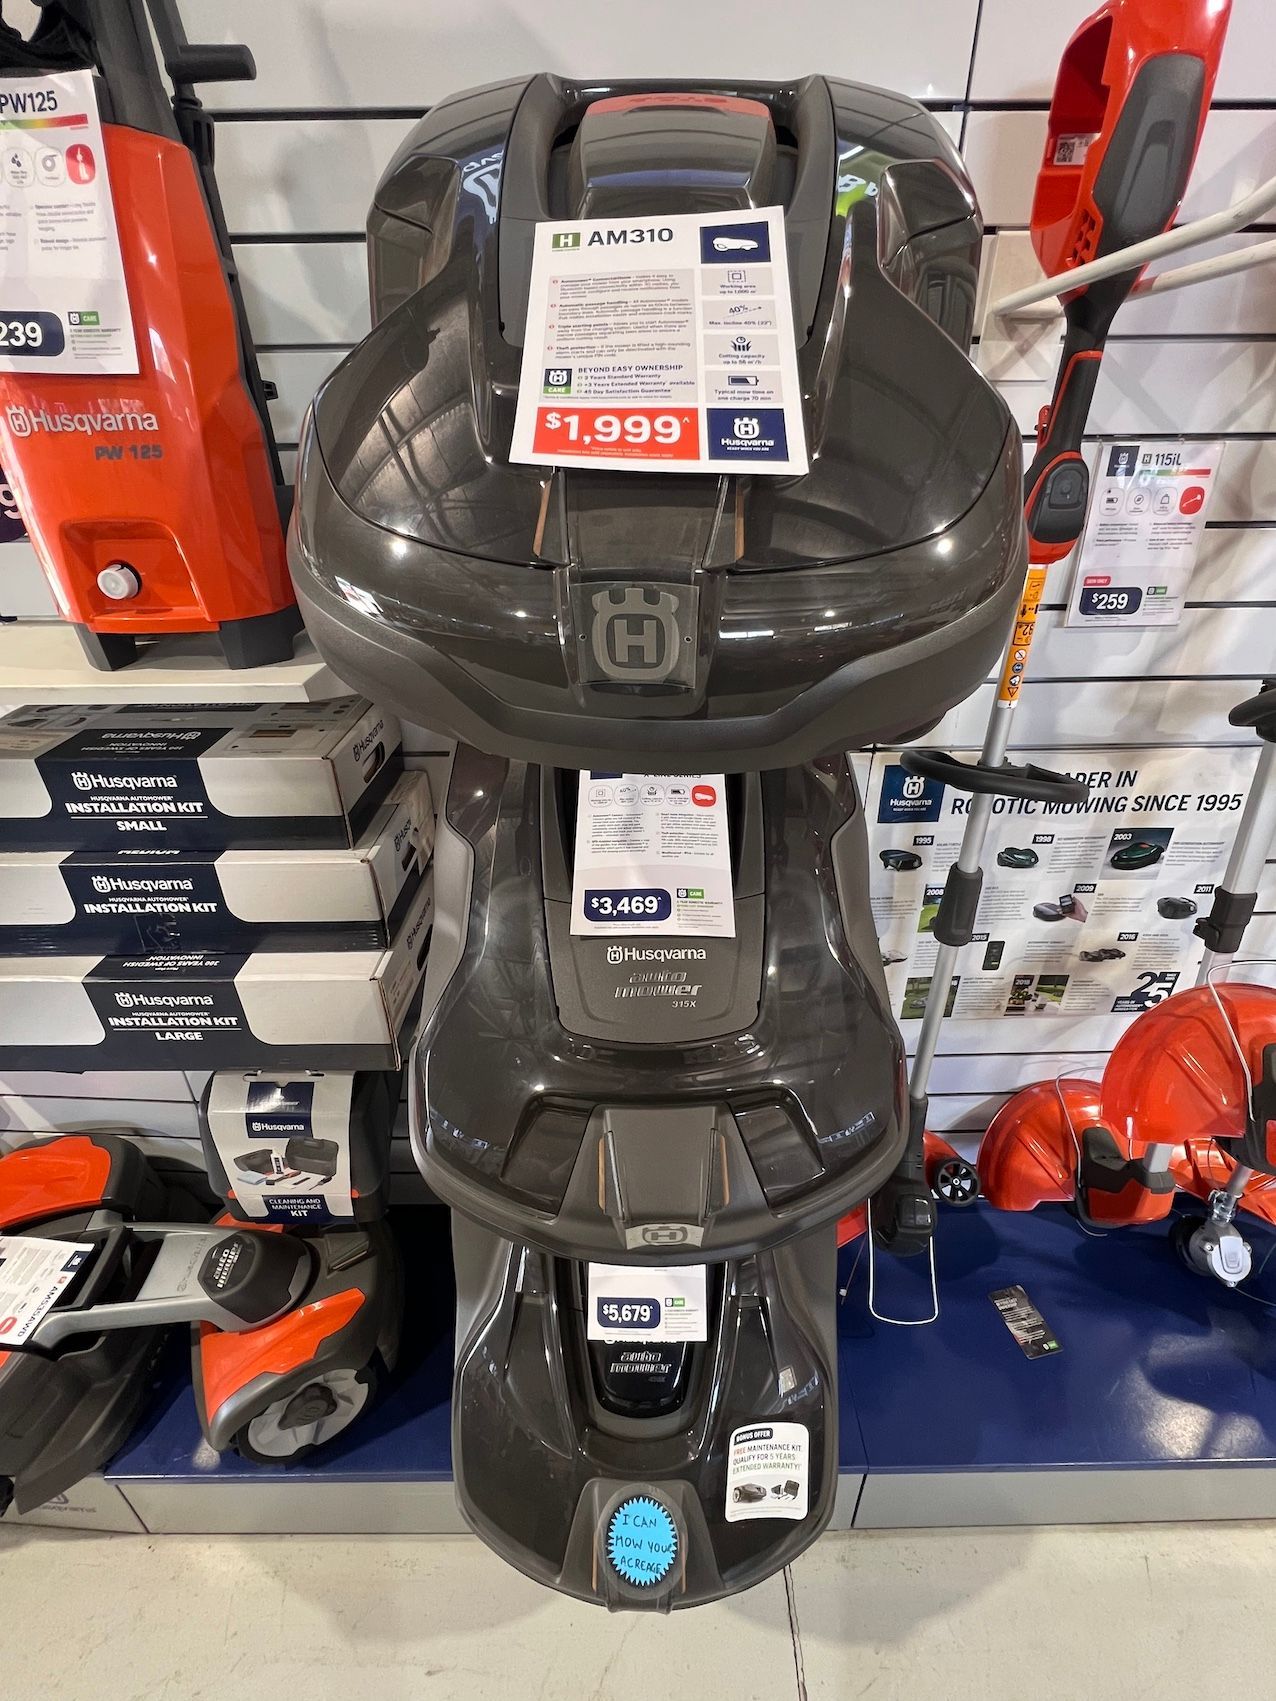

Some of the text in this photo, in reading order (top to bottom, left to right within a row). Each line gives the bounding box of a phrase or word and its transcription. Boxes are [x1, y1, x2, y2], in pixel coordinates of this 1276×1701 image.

[587, 228, 674, 247] AM310
[29, 408, 159, 436] Husqvarna
[721, 438, 775, 447] Husqvarna
[95, 445, 163, 460] PW 125
[1091, 593, 1129, 610] $259
[101, 732, 184, 740] Husqvarna
[90, 774, 178, 790] Husqvarna
[1115, 770, 1138, 787] IN
[65, 802, 203, 813] INSTALLATION KIT
[890, 798, 932, 806] Husqvarna
[951, 797, 1039, 815] ROTIC
[1131, 794, 1192, 812] SINCE
[1196, 793, 1244, 812] 1995
[116, 820, 168, 831] SMALL
[109, 878, 194, 892] Husqvarna
[83, 903, 217, 914] INSTALLATION KIT
[624, 947, 706, 962] Husqvarna
[614, 985, 703, 998] mower
[132, 994, 214, 1007] Husqvarna
[671, 1000, 697, 1008] 315X
[108, 1017, 238, 1026] INSTALLATION KIT
[155, 1032, 203, 1041] LARGE
[262, 1123, 304, 1132] Husqvarna
[736, 1430, 770, 1442] BONUS OFFER
[734, 1446, 746, 1456] FREE
[747, 1444, 790, 1452] MAINTENANCE
[732, 1455, 755, 1466] QUALIFY
[732, 1464, 761, 1475] EXTENDED
[622, 1514, 657, 1528] I CAN
[620, 1555, 662, 1575] ACREAGE
